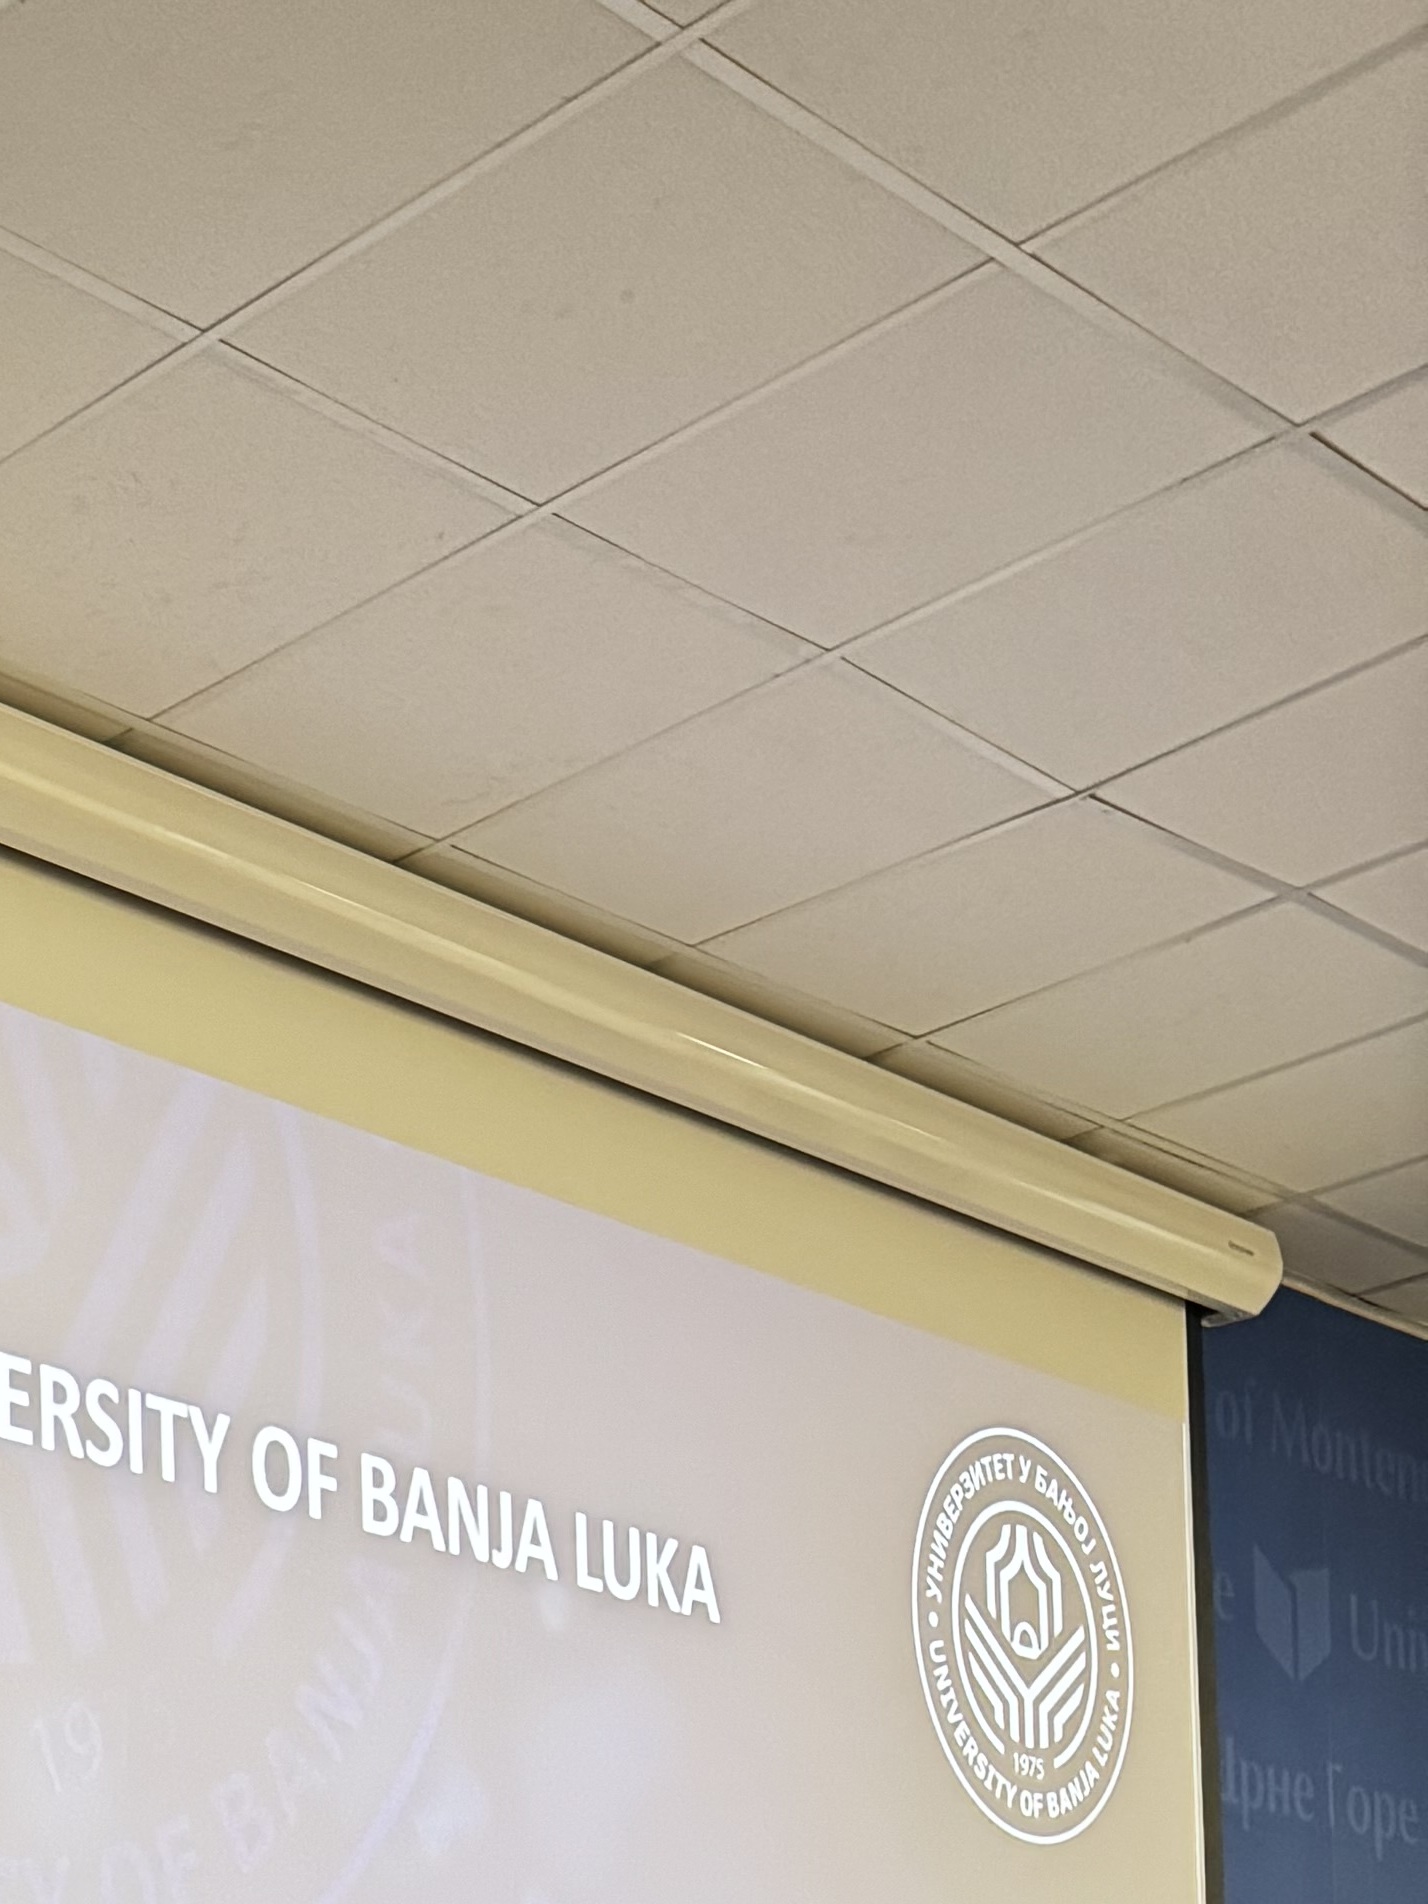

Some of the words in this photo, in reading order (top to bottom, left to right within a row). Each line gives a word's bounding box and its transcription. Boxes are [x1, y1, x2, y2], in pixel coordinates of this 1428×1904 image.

[251, 1426, 338, 1520] OF
[361, 1453, 559, 1582] BANJA
[574, 1511, 723, 1625] LUKA
[925, 1453, 1015, 1603] УНИВЕРЗИТЕТ
[1034, 1471, 1096, 1556] БАЊОЈ
[1089, 1562, 1121, 1652] ЛУЦИ
[929, 1640, 1018, 1810] UNIVERSITY
[1020, 1791, 1043, 1819] OF
[1048, 1762, 1100, 1819] BANJA
[1095, 1689, 1122, 1770] LUKA
